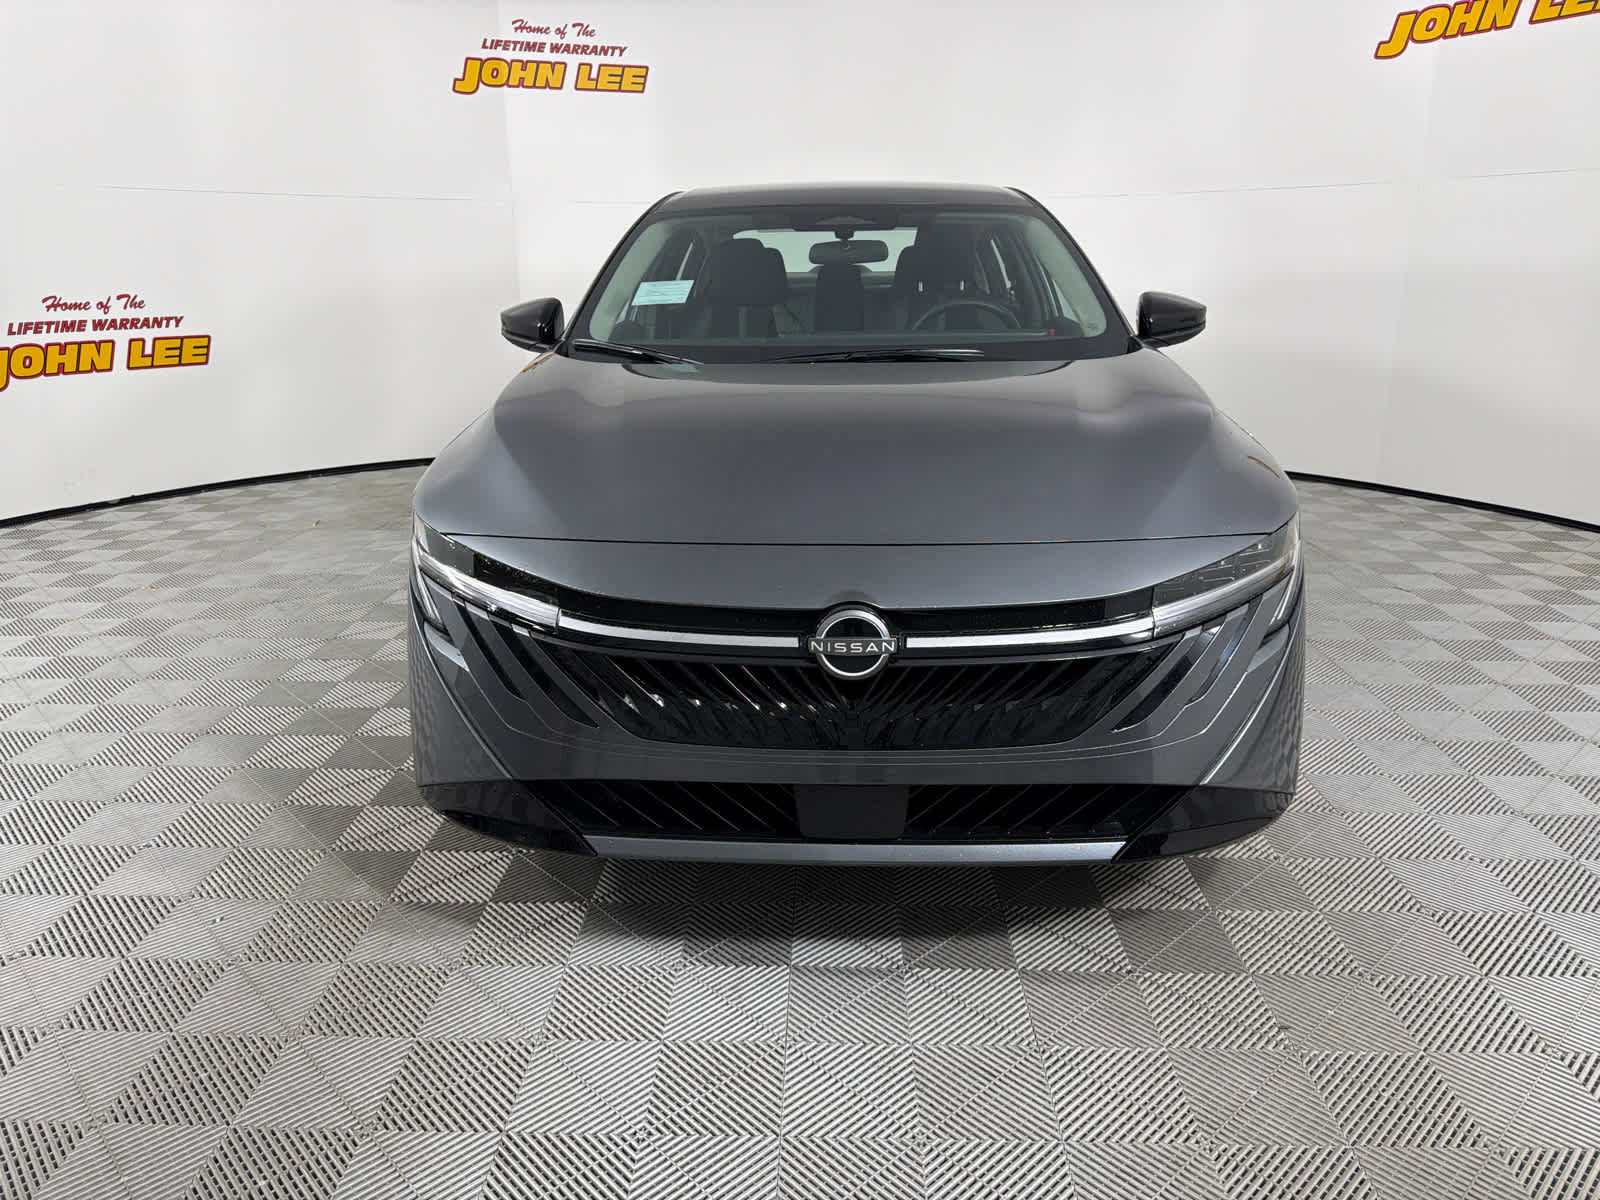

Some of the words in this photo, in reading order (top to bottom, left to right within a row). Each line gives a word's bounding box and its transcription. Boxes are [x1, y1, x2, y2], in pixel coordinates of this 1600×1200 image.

[511, 18, 551, 34] Home
[554, 24, 568, 40] of
[571, 22, 597, 38] The
[1374, 0, 1522, 60] JOHN
[481, 38, 546, 54] LIFETIME
[549, 42, 628, 57] WARRANTY
[452, 56, 568, 95] JOHN
[574, 62, 649, 94] LEE
[41, 295, 91, 312] Home
[95, 296, 111, 314] of
[116, 293, 146, 310] The
[7, 319, 88, 336] LIFETIME
[91, 315, 184, 331] WARRANTY
[127, 334, 211, 370] LEE
[810, 640, 895, 653] NISSAN
